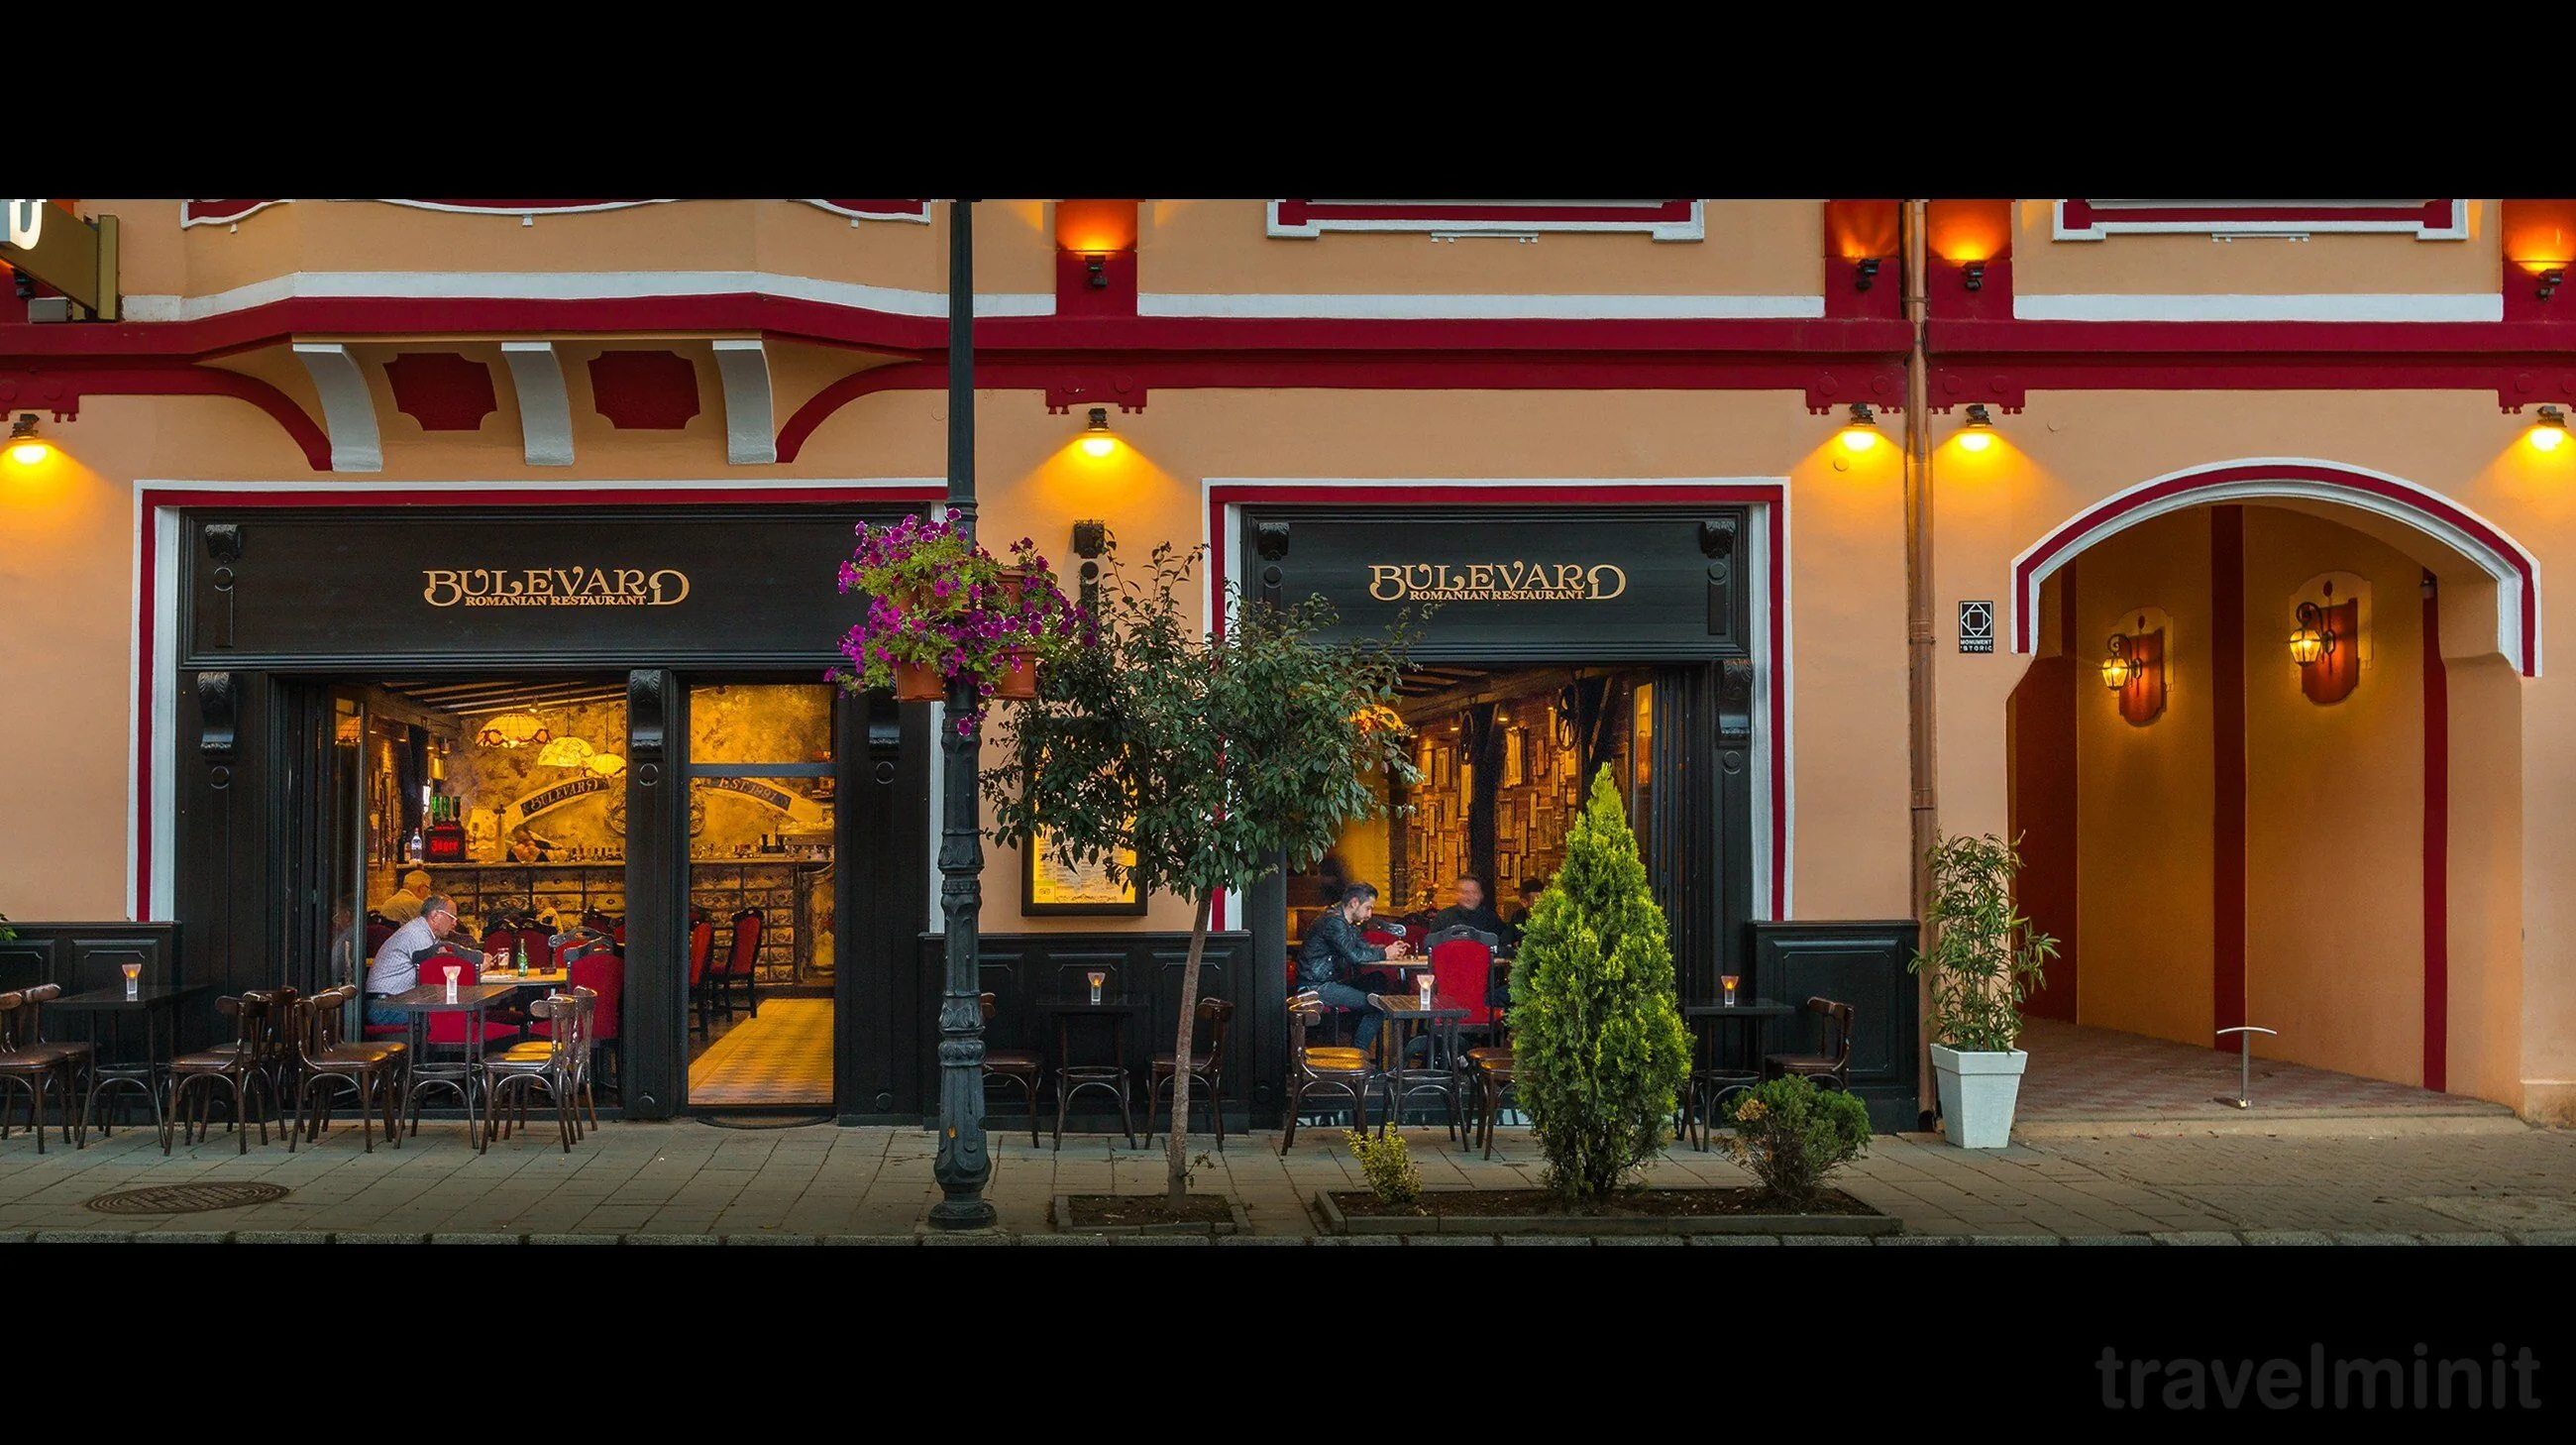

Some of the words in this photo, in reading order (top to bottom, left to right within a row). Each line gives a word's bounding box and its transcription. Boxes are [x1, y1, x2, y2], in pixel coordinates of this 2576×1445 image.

[422, 566, 691, 607] BULEVARD
[1367, 561, 1627, 601] BULEVARD
[1409, 590, 1489, 601] ROMANIAN
[1491, 590, 1585, 601] RESTAURANT
[465, 596, 546, 607] ROMANIAN
[550, 596, 646, 606] RESTAURANT
[531, 779, 598, 811] BULEVARD
